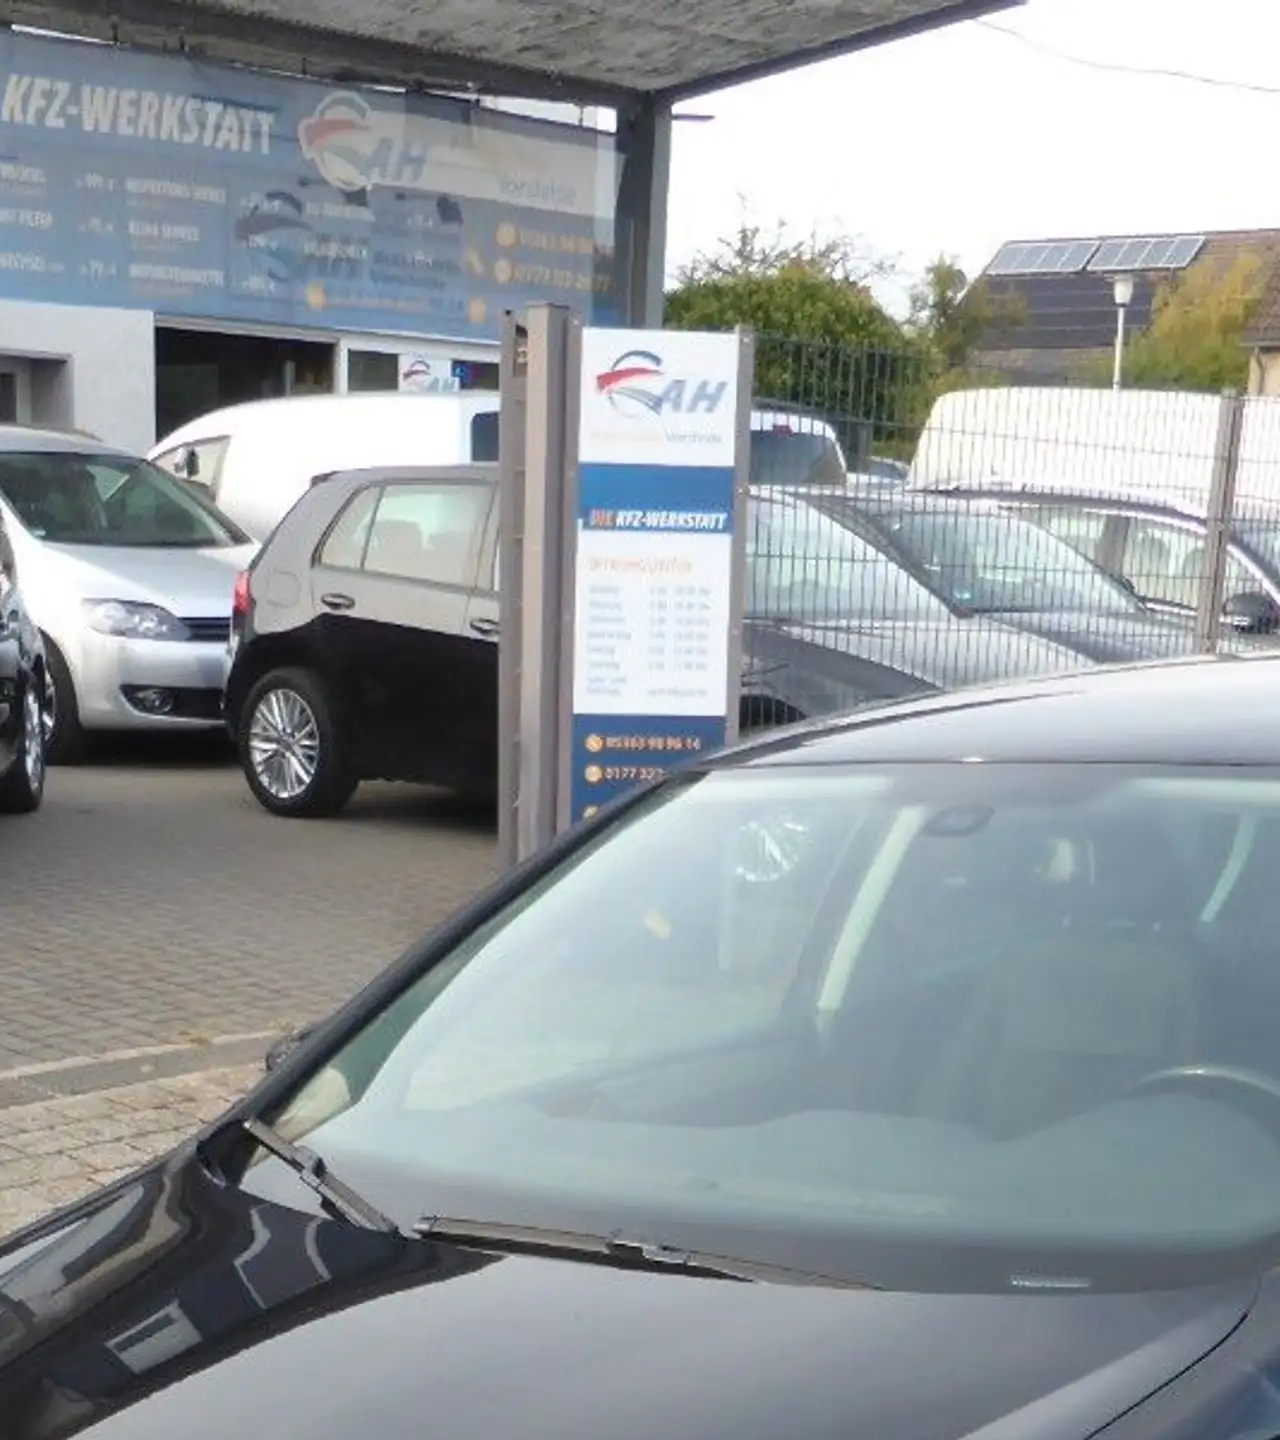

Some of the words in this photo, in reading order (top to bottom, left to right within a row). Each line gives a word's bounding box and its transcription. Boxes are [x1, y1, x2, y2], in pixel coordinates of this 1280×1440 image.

[0, 73, 277, 154] KFZ-WERKSTATT
[657, 379, 729, 414] AH
[590, 508, 615, 528] DIE
[616, 510, 728, 530] KFZ-WERKSTATT
